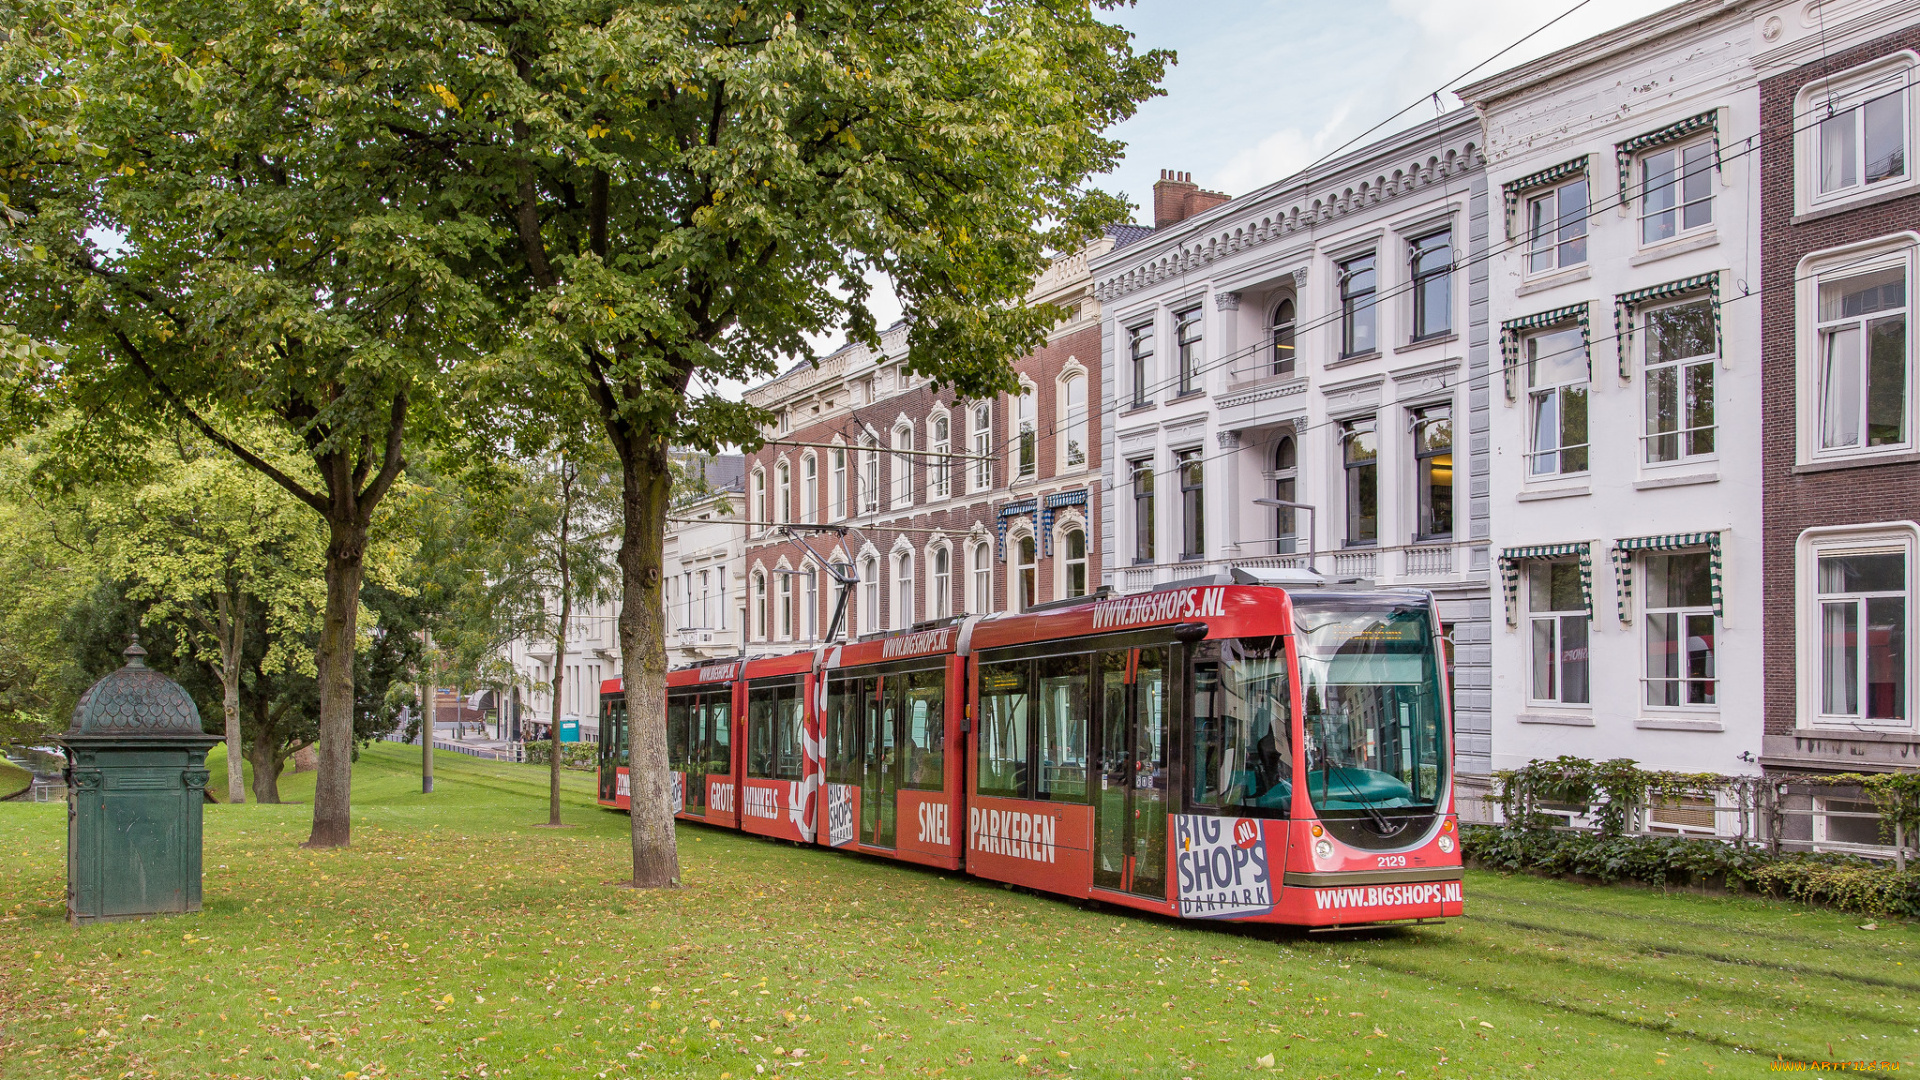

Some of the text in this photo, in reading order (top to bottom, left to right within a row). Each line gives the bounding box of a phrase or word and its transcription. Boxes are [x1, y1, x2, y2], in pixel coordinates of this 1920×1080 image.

[1093, 587, 1226, 629] WWW.BIGSHOPS.NL
[882, 629, 949, 659] WWW.BIGSHOPS.NL
[711, 782, 778, 820] GROTE WINKELS
[830, 784, 841, 805] BIG
[830, 799, 852, 831] SHOPS
[918, 801, 1055, 864] SNEL PARKEREN
[1178, 815, 1221, 849] BIG
[1179, 840, 1267, 893] SHOPS
[1377, 855, 1406, 867] 2129
[1183, 887, 1266, 914] DAKPARK
[1315, 883, 1462, 909] WWW.BIGSHOPS.NL
